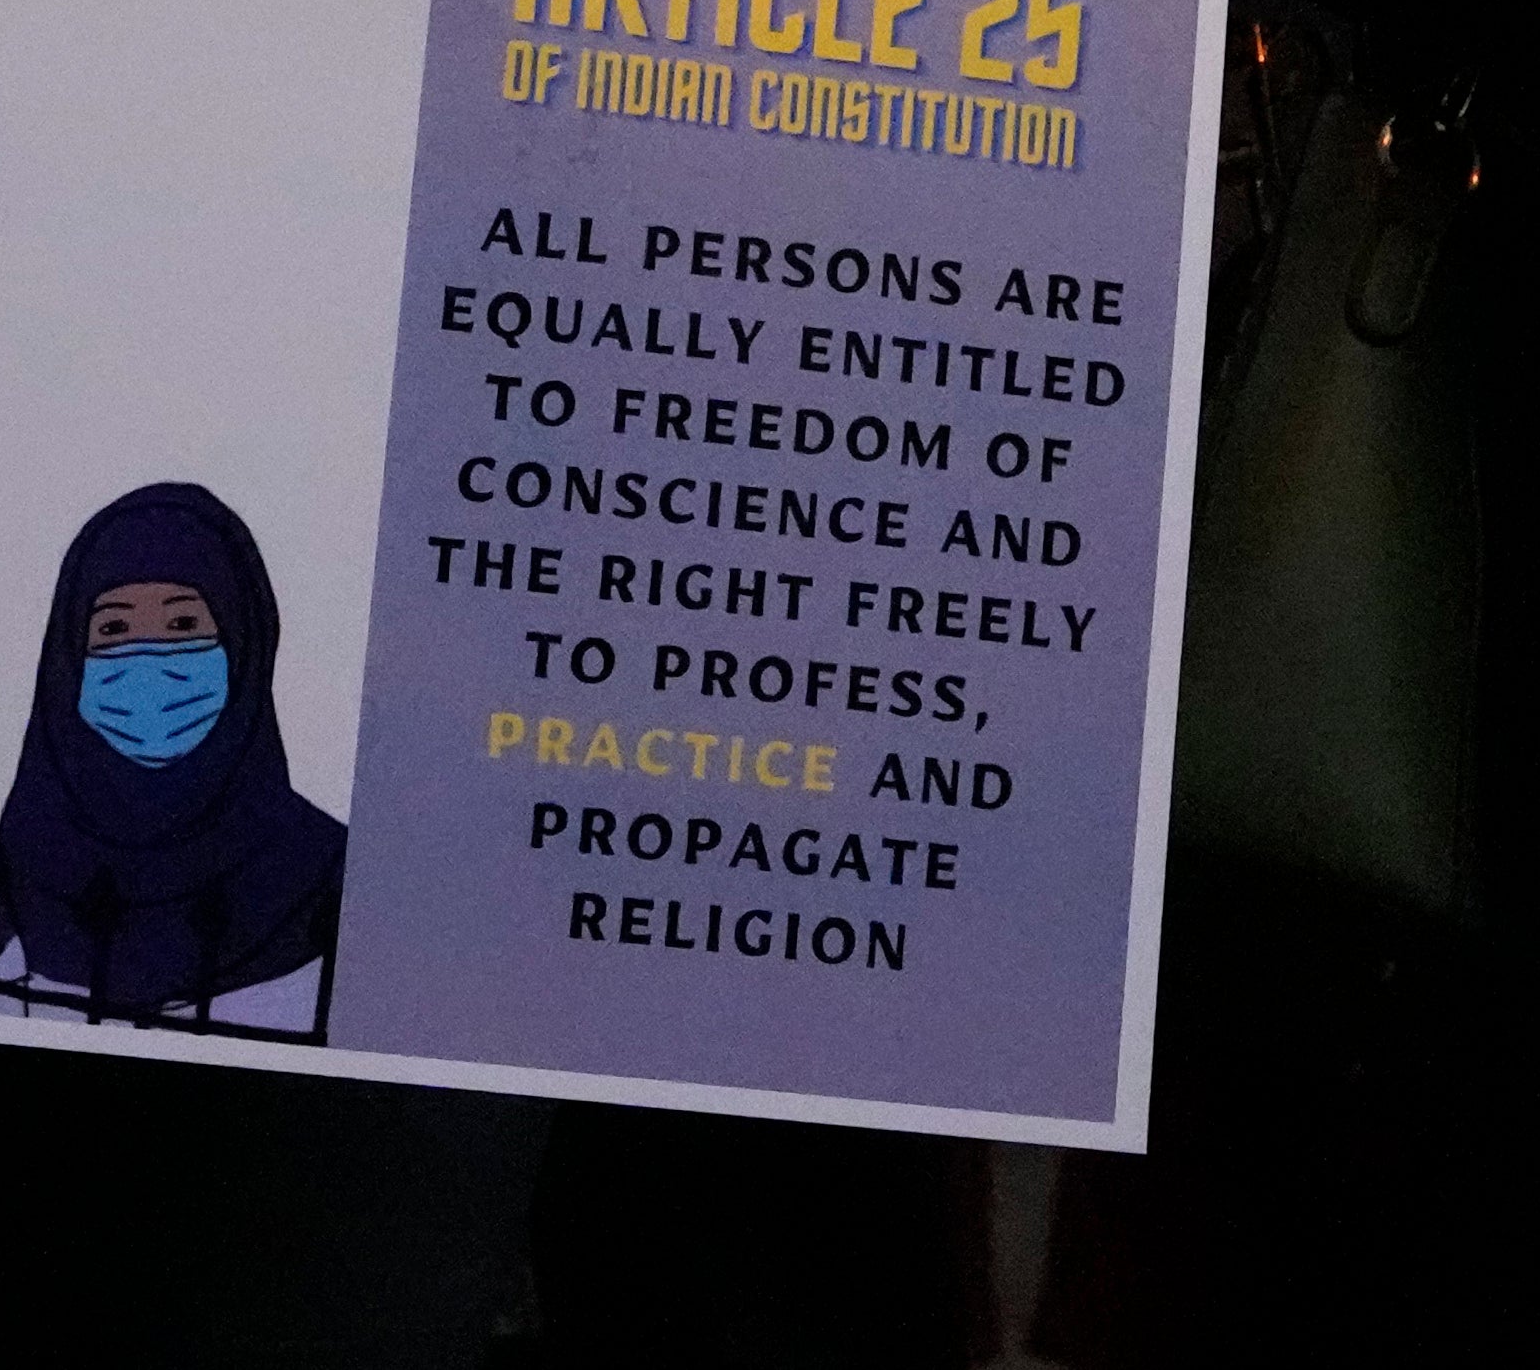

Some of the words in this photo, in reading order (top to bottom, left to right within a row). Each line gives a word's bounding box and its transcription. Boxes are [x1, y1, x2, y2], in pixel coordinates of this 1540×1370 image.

[501, 39, 566, 104] OF
[576, 45, 734, 126] INDIAN
[748, 71, 1079, 171] CONSTITUTION
[481, 207, 608, 264] ALL
[642, 225, 964, 307] PERSONS
[994, 268, 1125, 328] ARE
[440, 286, 766, 366] EQUALLY
[799, 326, 1127, 408] ENTITLED
[484, 374, 577, 428] TO
[612, 387, 952, 471] FREEDOM
[985, 431, 1074, 484] OF
[456, 456, 910, 549] CONSCIENCE
[940, 507, 1082, 569] AND
[427, 535, 564, 596] THE
[598, 555, 814, 623] RIGHT
[845, 581, 1097, 653] FREELY
[525, 631, 617, 685] TO
[652, 645, 991, 734] PROFESS,
[487, 711, 838, 792] PRACTICE
[869, 751, 1014, 811] AND
[529, 802, 961, 891] PROPAGATE
[568, 891, 907, 971] RELIGION
